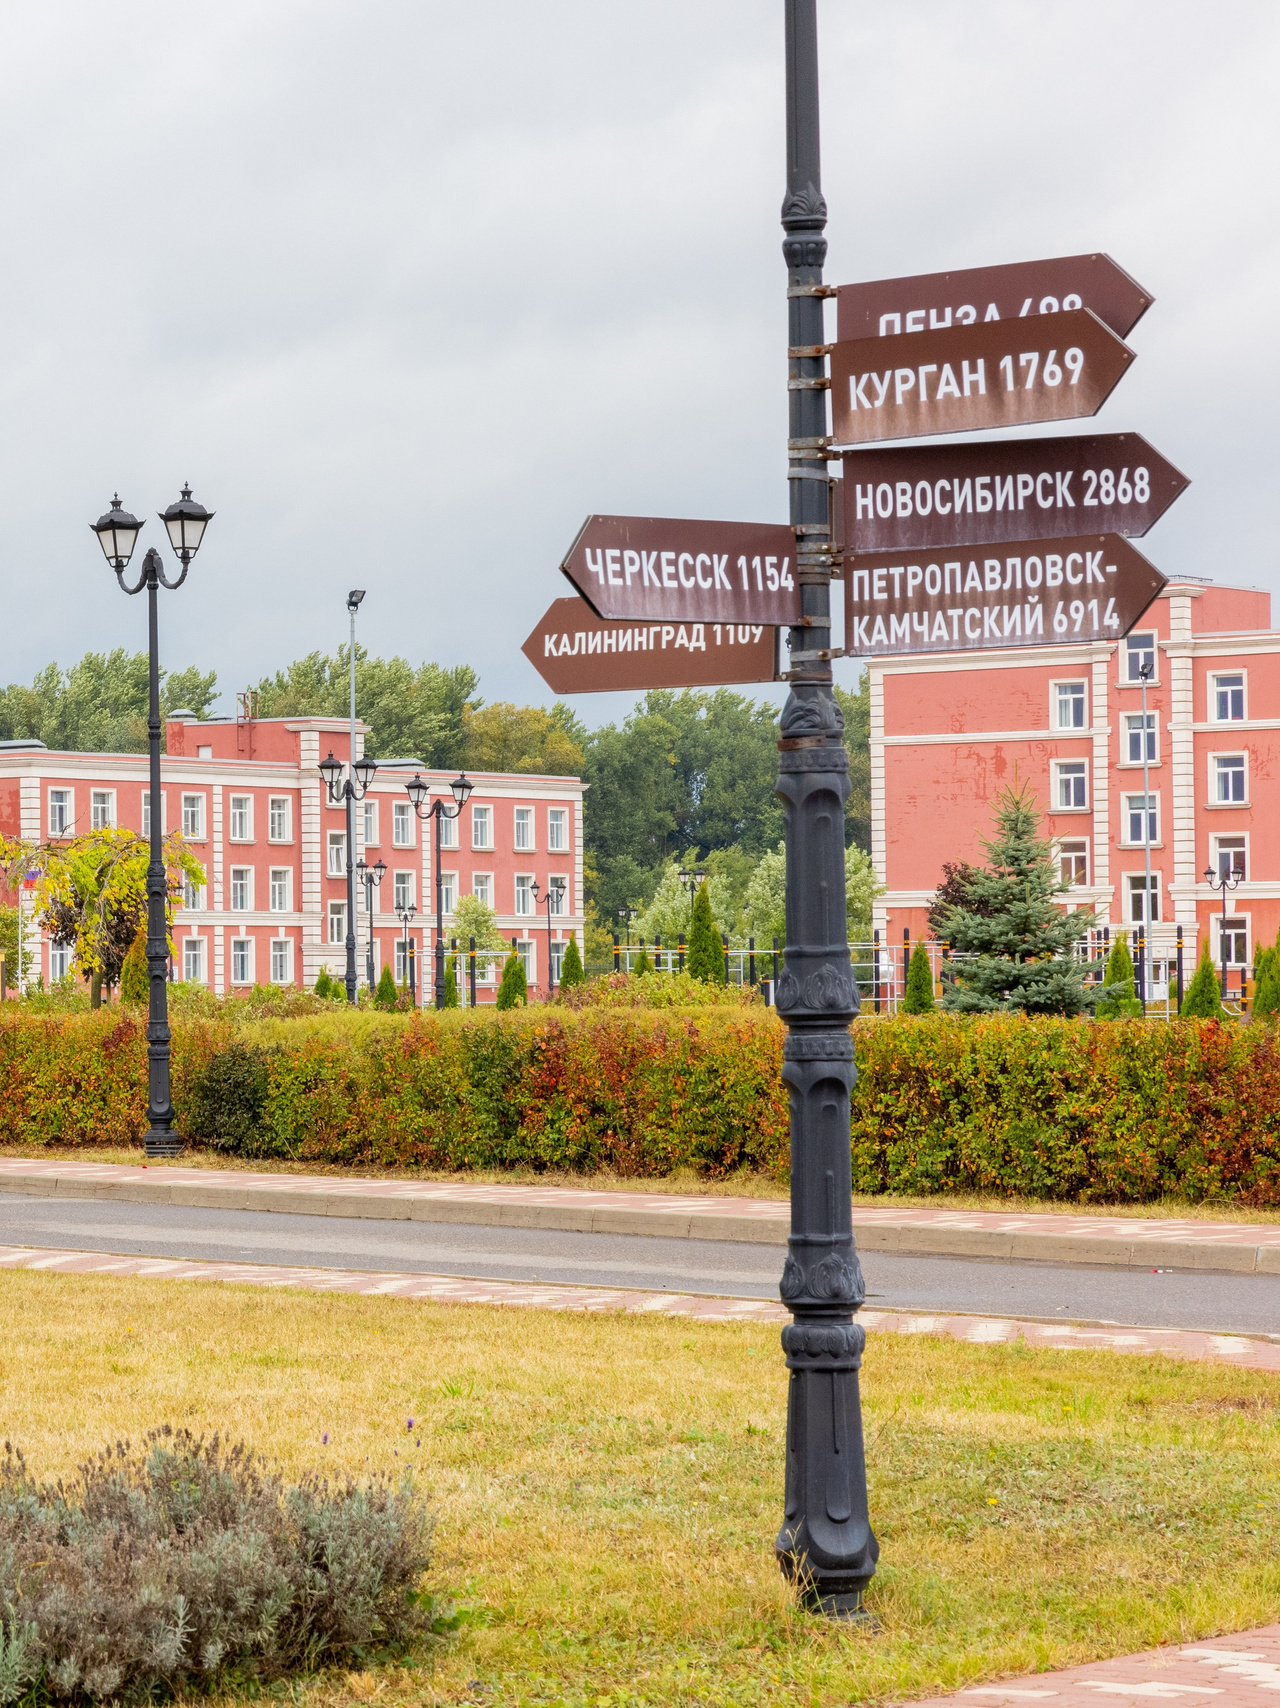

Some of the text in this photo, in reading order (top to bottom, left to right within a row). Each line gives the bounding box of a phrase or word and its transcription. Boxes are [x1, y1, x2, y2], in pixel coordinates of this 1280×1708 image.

[849, 347, 1084, 411] КУРГАН 1769
[855, 466, 1151, 520] НОВОСИБИРСК 2868
[585, 547, 795, 592] ЧЕРКЕССК 1154
[853, 550, 1118, 601] ПЕТРОПАВЛОВСК-
[544, 623, 763, 657] КАЛИНИНГРАД 1109
[853, 595, 1120, 647] КАМЧАТСКИЙ 6914
